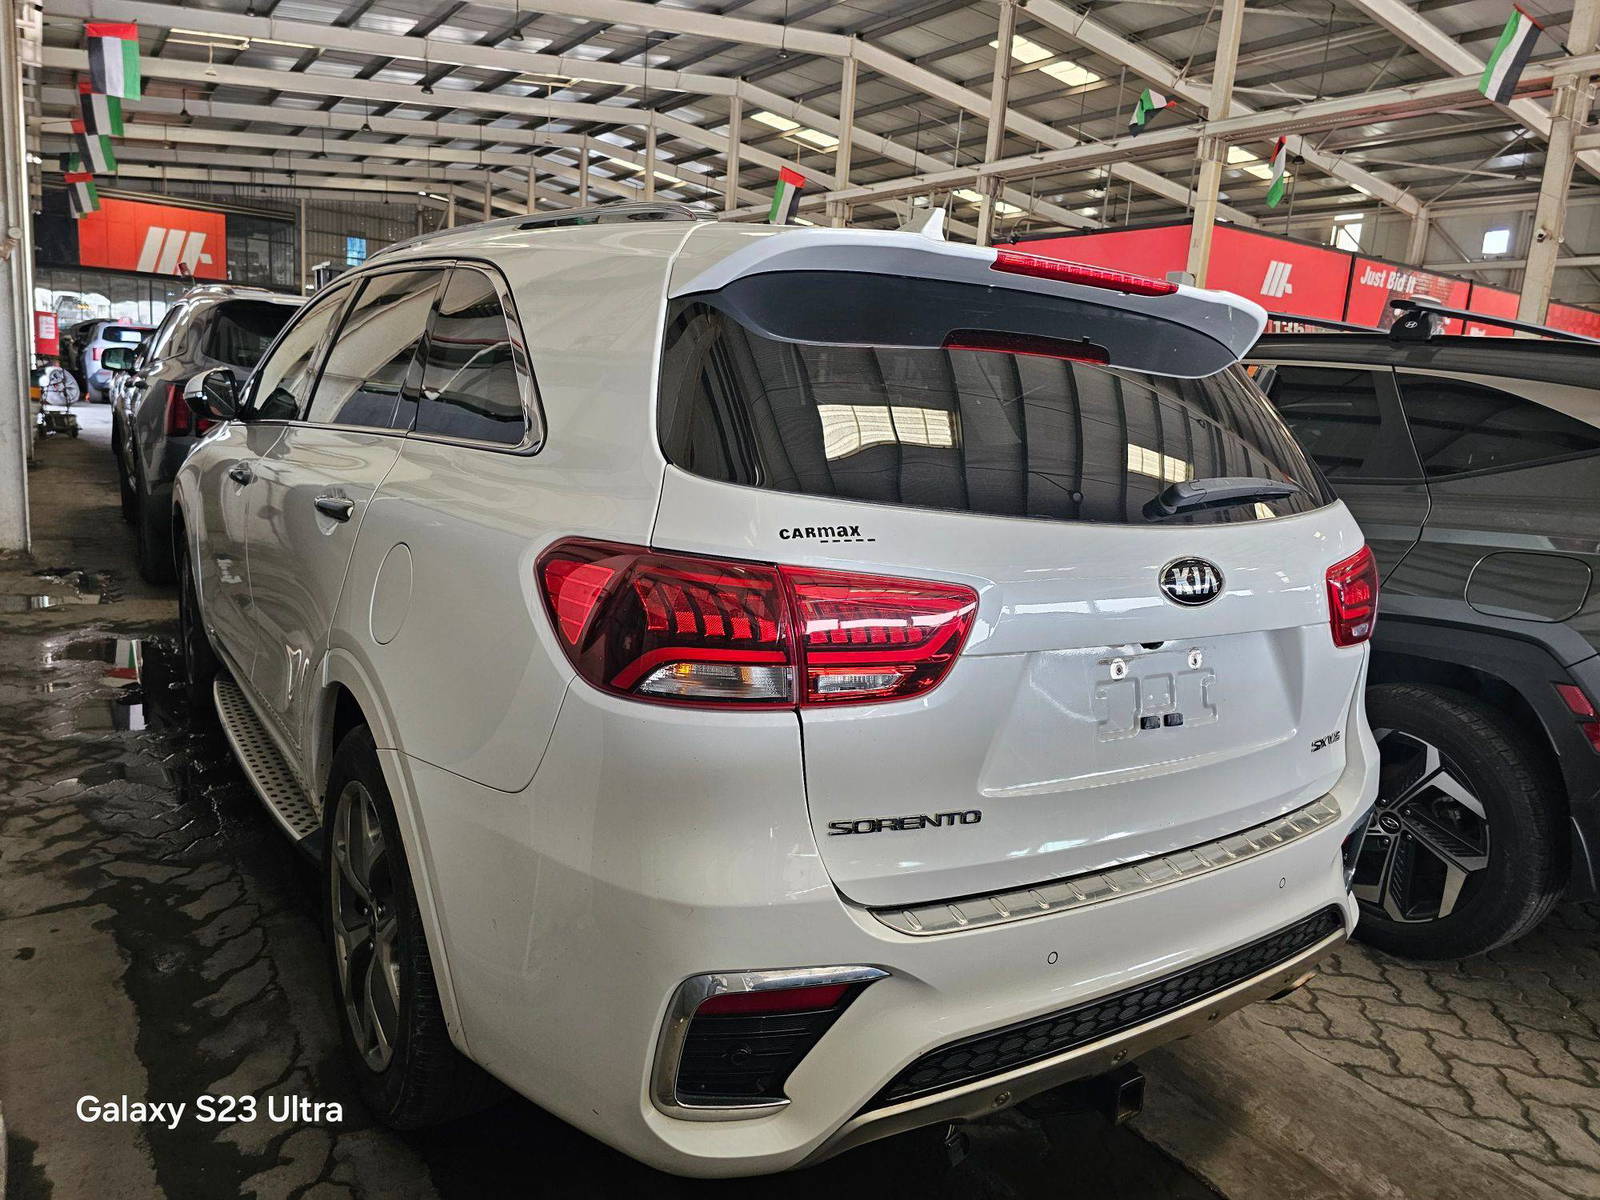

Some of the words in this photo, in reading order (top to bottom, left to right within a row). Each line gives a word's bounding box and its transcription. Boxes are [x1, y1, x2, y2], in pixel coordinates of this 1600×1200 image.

[1360, 265, 1387, 288] Just
[1386, 270, 1408, 292] Bid
[1171, 566, 1219, 595] KIA
[828, 809, 983, 836] SORENTO
